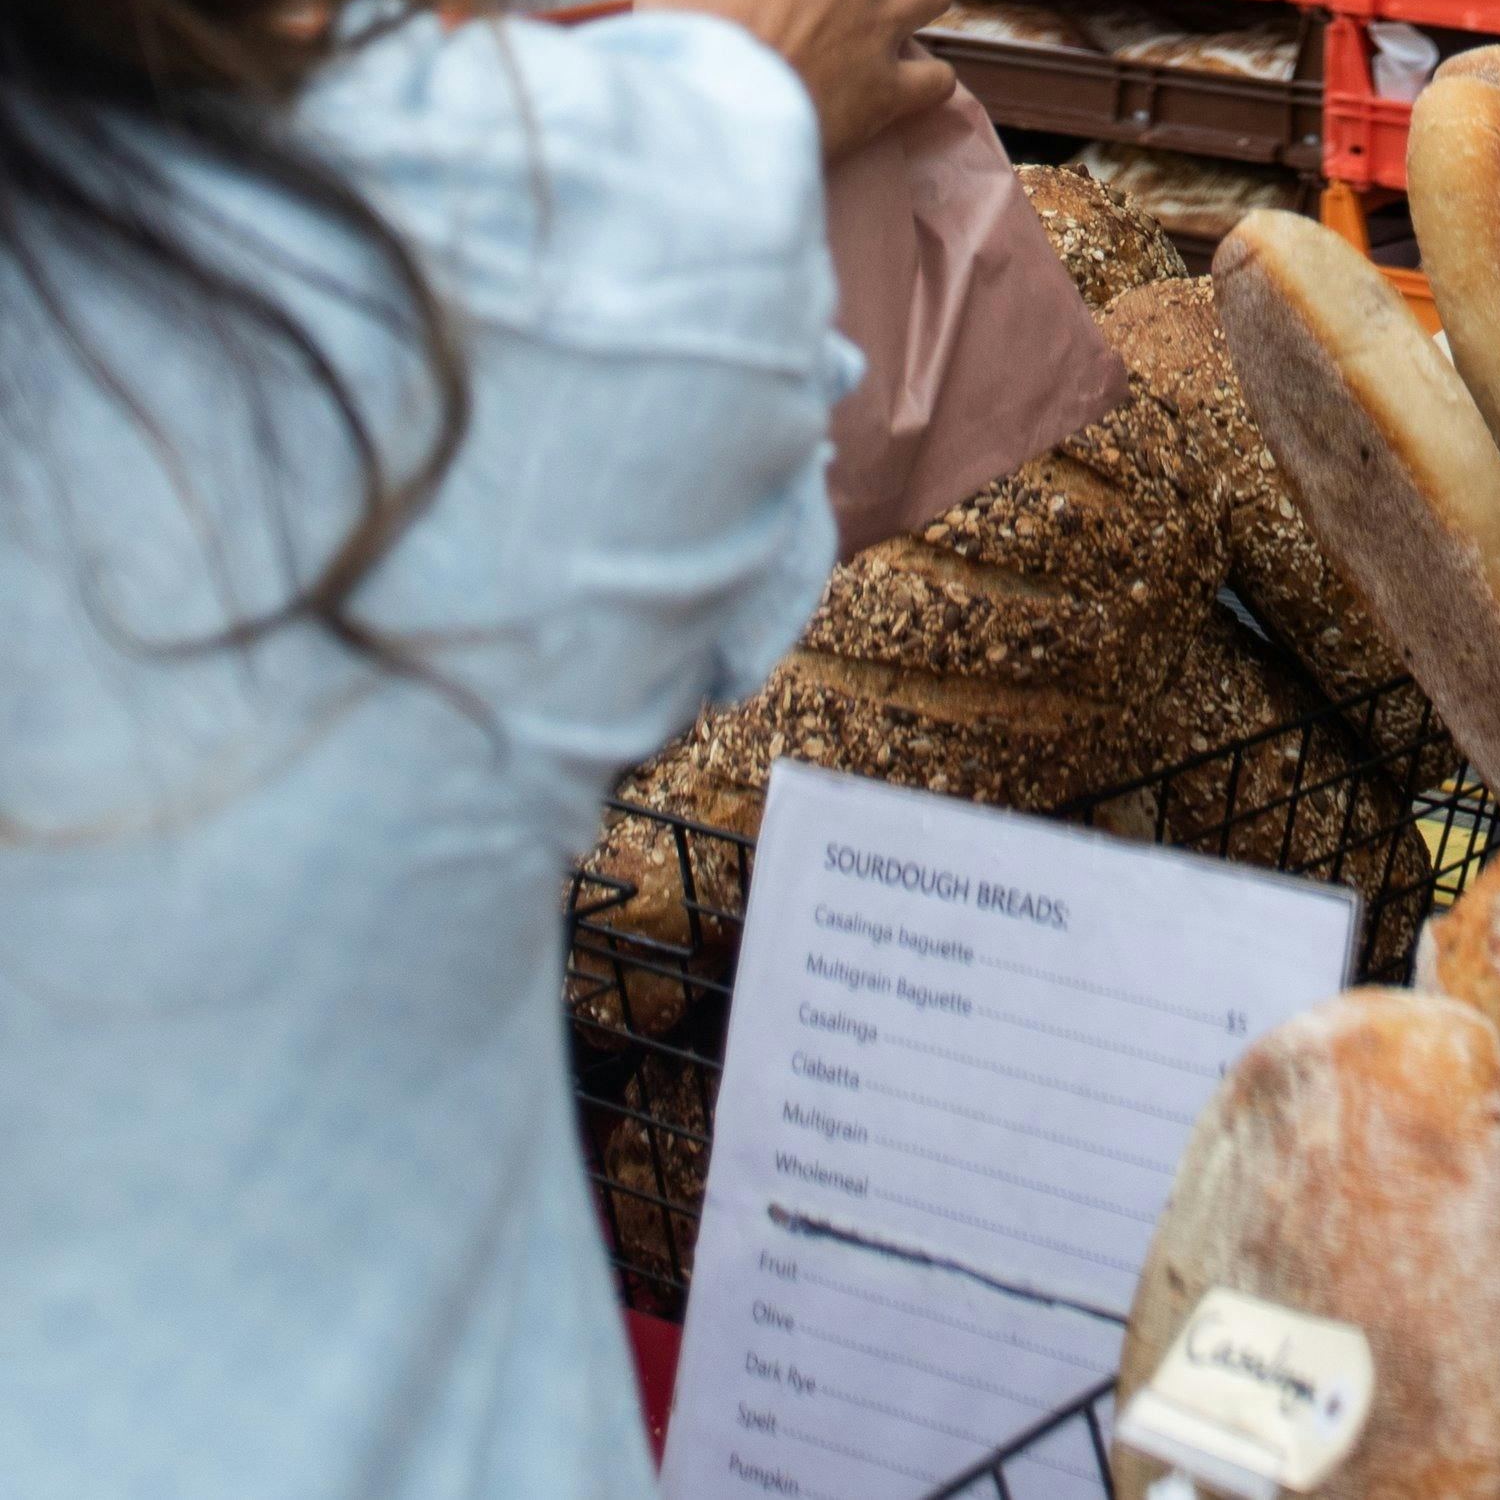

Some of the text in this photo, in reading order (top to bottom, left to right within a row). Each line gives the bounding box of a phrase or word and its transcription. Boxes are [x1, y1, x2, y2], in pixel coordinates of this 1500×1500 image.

[825, 842, 1069, 931] SOURDOUGH BREADS:
[815, 903, 893, 945] Casalinga
[898, 923, 974, 965] baguette
[806, 951, 974, 1016] Multigrain Baguette
[799, 1001, 878, 1044] Casalinga
[791, 1049, 861, 1091] Ciabatta
[782, 1100, 869, 1143] Multigrain
[775, 1150, 869, 1198] Wholemeal
[759, 1249, 799, 1282] Fruit
[752, 1299, 795, 1332] Olive
[745, 1349, 817, 1396] Dark Rye
[737, 1400, 777, 1434] Spelt
[728, 1452, 800, 1496] Pumpkin
